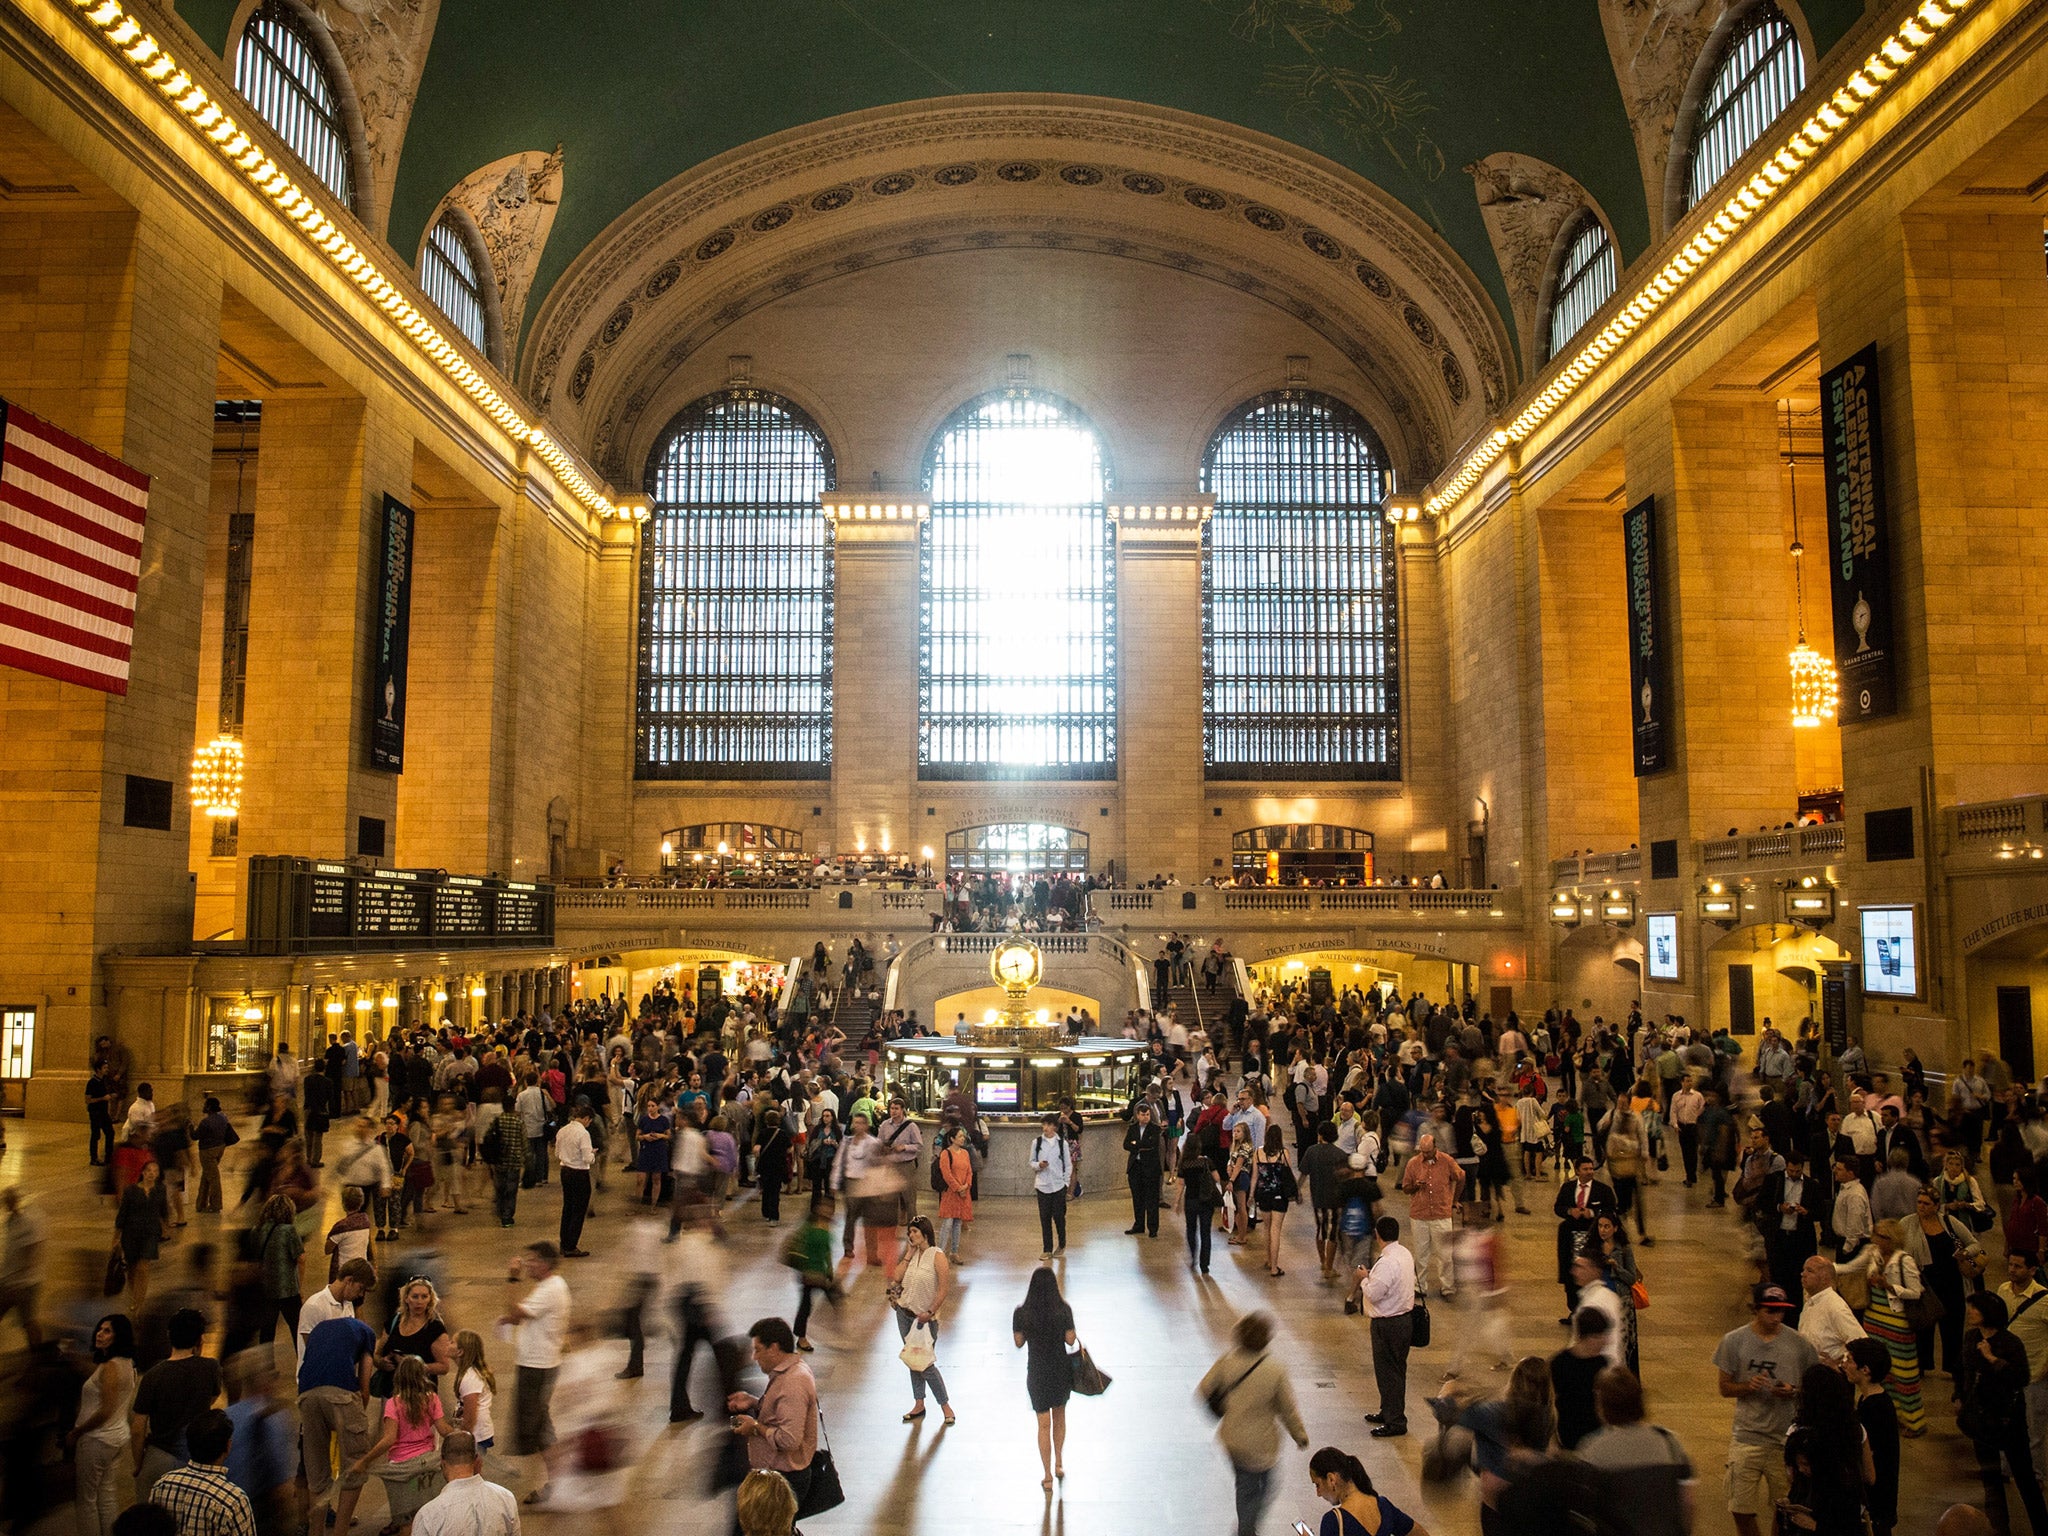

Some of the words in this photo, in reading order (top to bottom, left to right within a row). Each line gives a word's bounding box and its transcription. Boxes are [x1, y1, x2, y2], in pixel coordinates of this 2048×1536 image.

[1854, 364, 1865, 387] A
[1832, 376, 1846, 447] ISN'T
[1836, 451, 1848, 477] IT
[1843, 370, 1864, 556] CELEBRATION
[1856, 387, 1876, 560] CENTENNIAL
[1838, 481, 1853, 581] GRAND
[1862, 650, 1884, 661] CENTRAL
[1962, 929, 1981, 949] THE
[1981, 910, 2022, 938] METLIFE
[579, 940, 616, 954] SUBWAY
[618, 937, 660, 948] SHUTTLE
[691, 938, 714, 947] 42ND
[715, 939, 748, 951] STREET
[678, 953, 710, 962] SUBWAY
[1265, 944, 1296, 957] TICKET
[1299, 938, 1346, 950] MACHINES
[1376, 938, 1411, 949] TRACKS
[1423, 943, 1436, 953] TO
[1318, 952, 1353, 962] WAITING
[1356, 955, 1378, 965] ROOM
